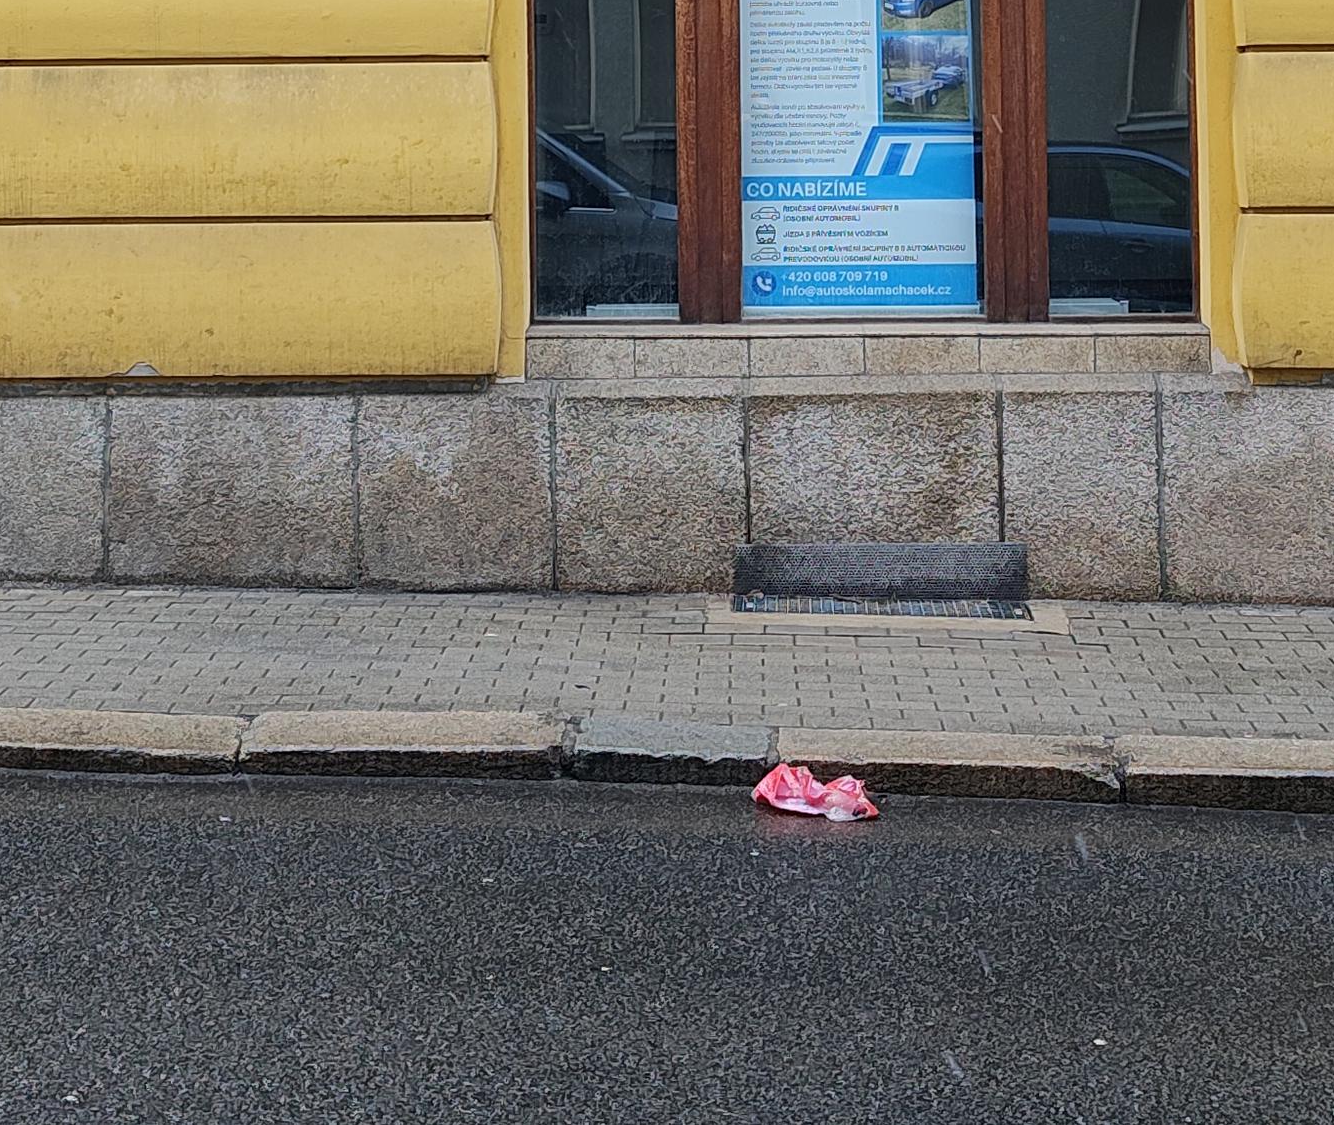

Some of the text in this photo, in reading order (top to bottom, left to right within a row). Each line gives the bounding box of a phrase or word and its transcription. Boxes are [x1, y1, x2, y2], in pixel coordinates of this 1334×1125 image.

[746, 181, 867, 197] CO NABÍZÍME
[839, 272, 862, 281] 709
[866, 272, 888, 281] 719
